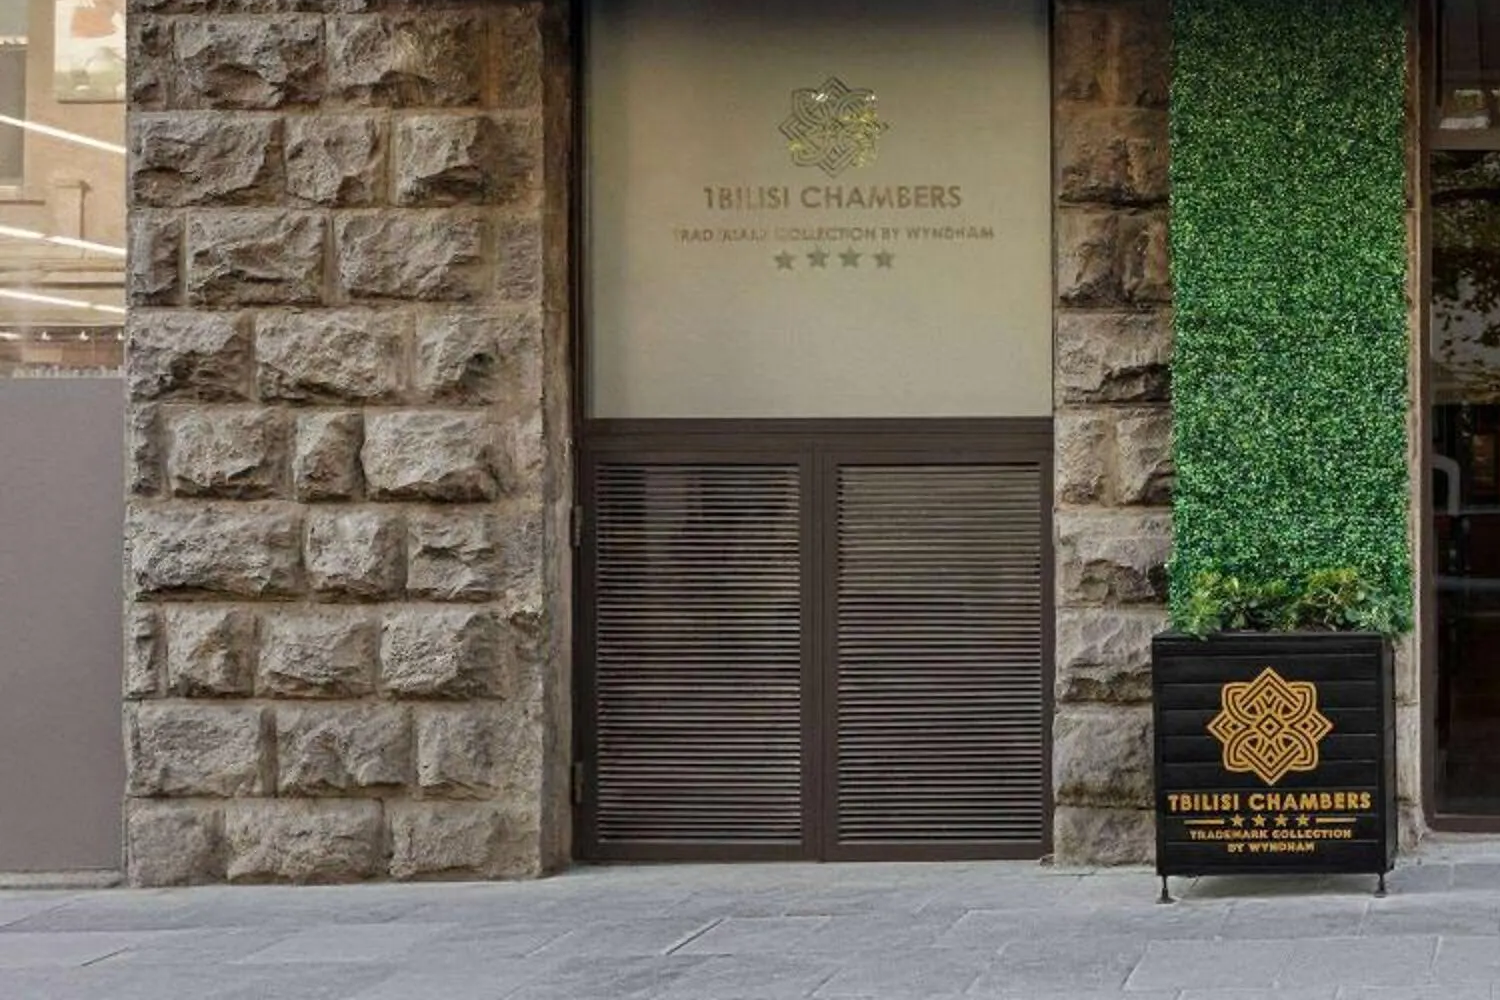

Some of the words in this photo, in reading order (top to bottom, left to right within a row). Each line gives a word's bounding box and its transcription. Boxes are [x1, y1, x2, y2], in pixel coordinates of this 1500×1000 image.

[800, 185, 963, 209] CHAMBERS
[1168, 794, 1239, 811] TBILISI
[1249, 793, 1371, 810] CHAMBERS
[1189, 829, 1268, 840] TRADEMARK
[1272, 829, 1352, 839] COLLECTION
